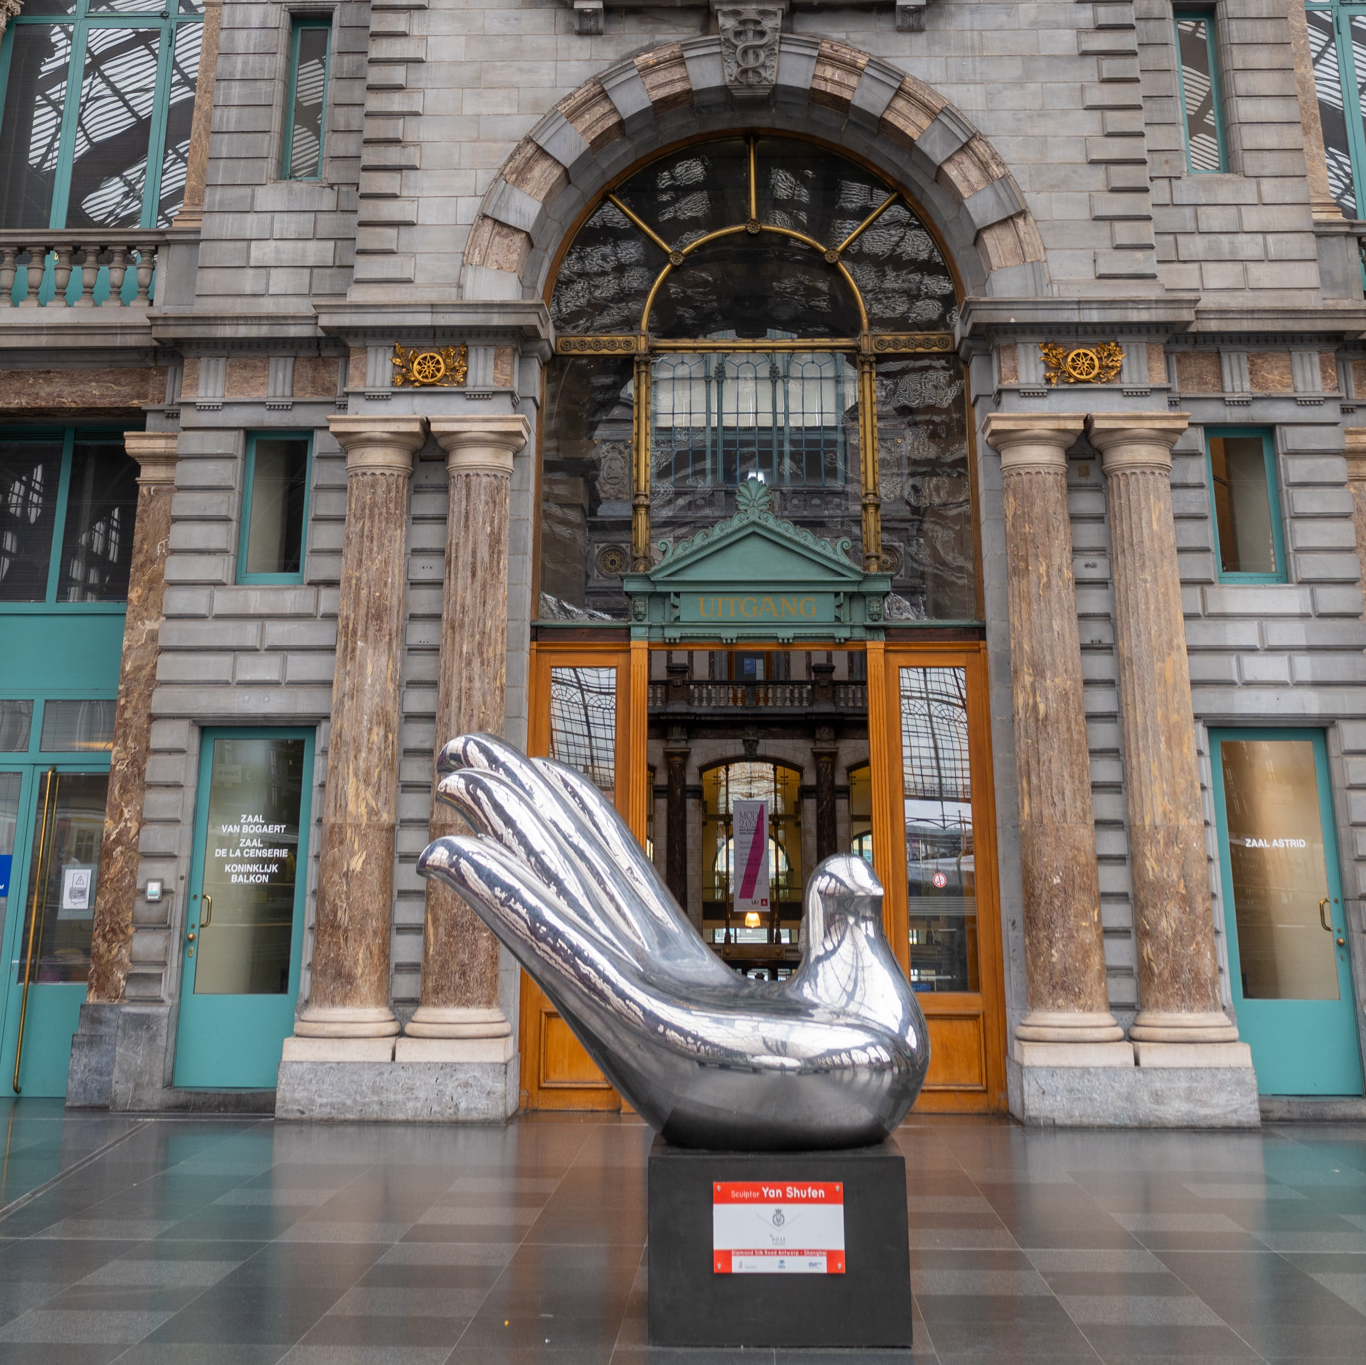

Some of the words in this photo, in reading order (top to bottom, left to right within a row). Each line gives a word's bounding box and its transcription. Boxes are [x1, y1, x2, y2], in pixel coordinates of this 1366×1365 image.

[698, 597, 817, 618] UITGANG
[240, 814, 265, 823] ZAAL
[222, 824, 241, 833] VAN
[242, 824, 286, 834] BOGAERT
[239, 838, 263, 847] ZAAL
[1245, 838, 1270, 848] ZAAL
[1272, 838, 1306, 848] ASTRID
[215, 848, 228, 857] DE
[229, 848, 241, 857] LA
[243, 848, 288, 858] CENSERIE
[225, 864, 278, 873] KONINKLIJK
[231, 874, 269, 883] BALKON
[731, 1190, 759, 1199] Sculptor
[762, 1186, 782, 1198] Yan
[786, 1186, 825, 1198] Shufen
